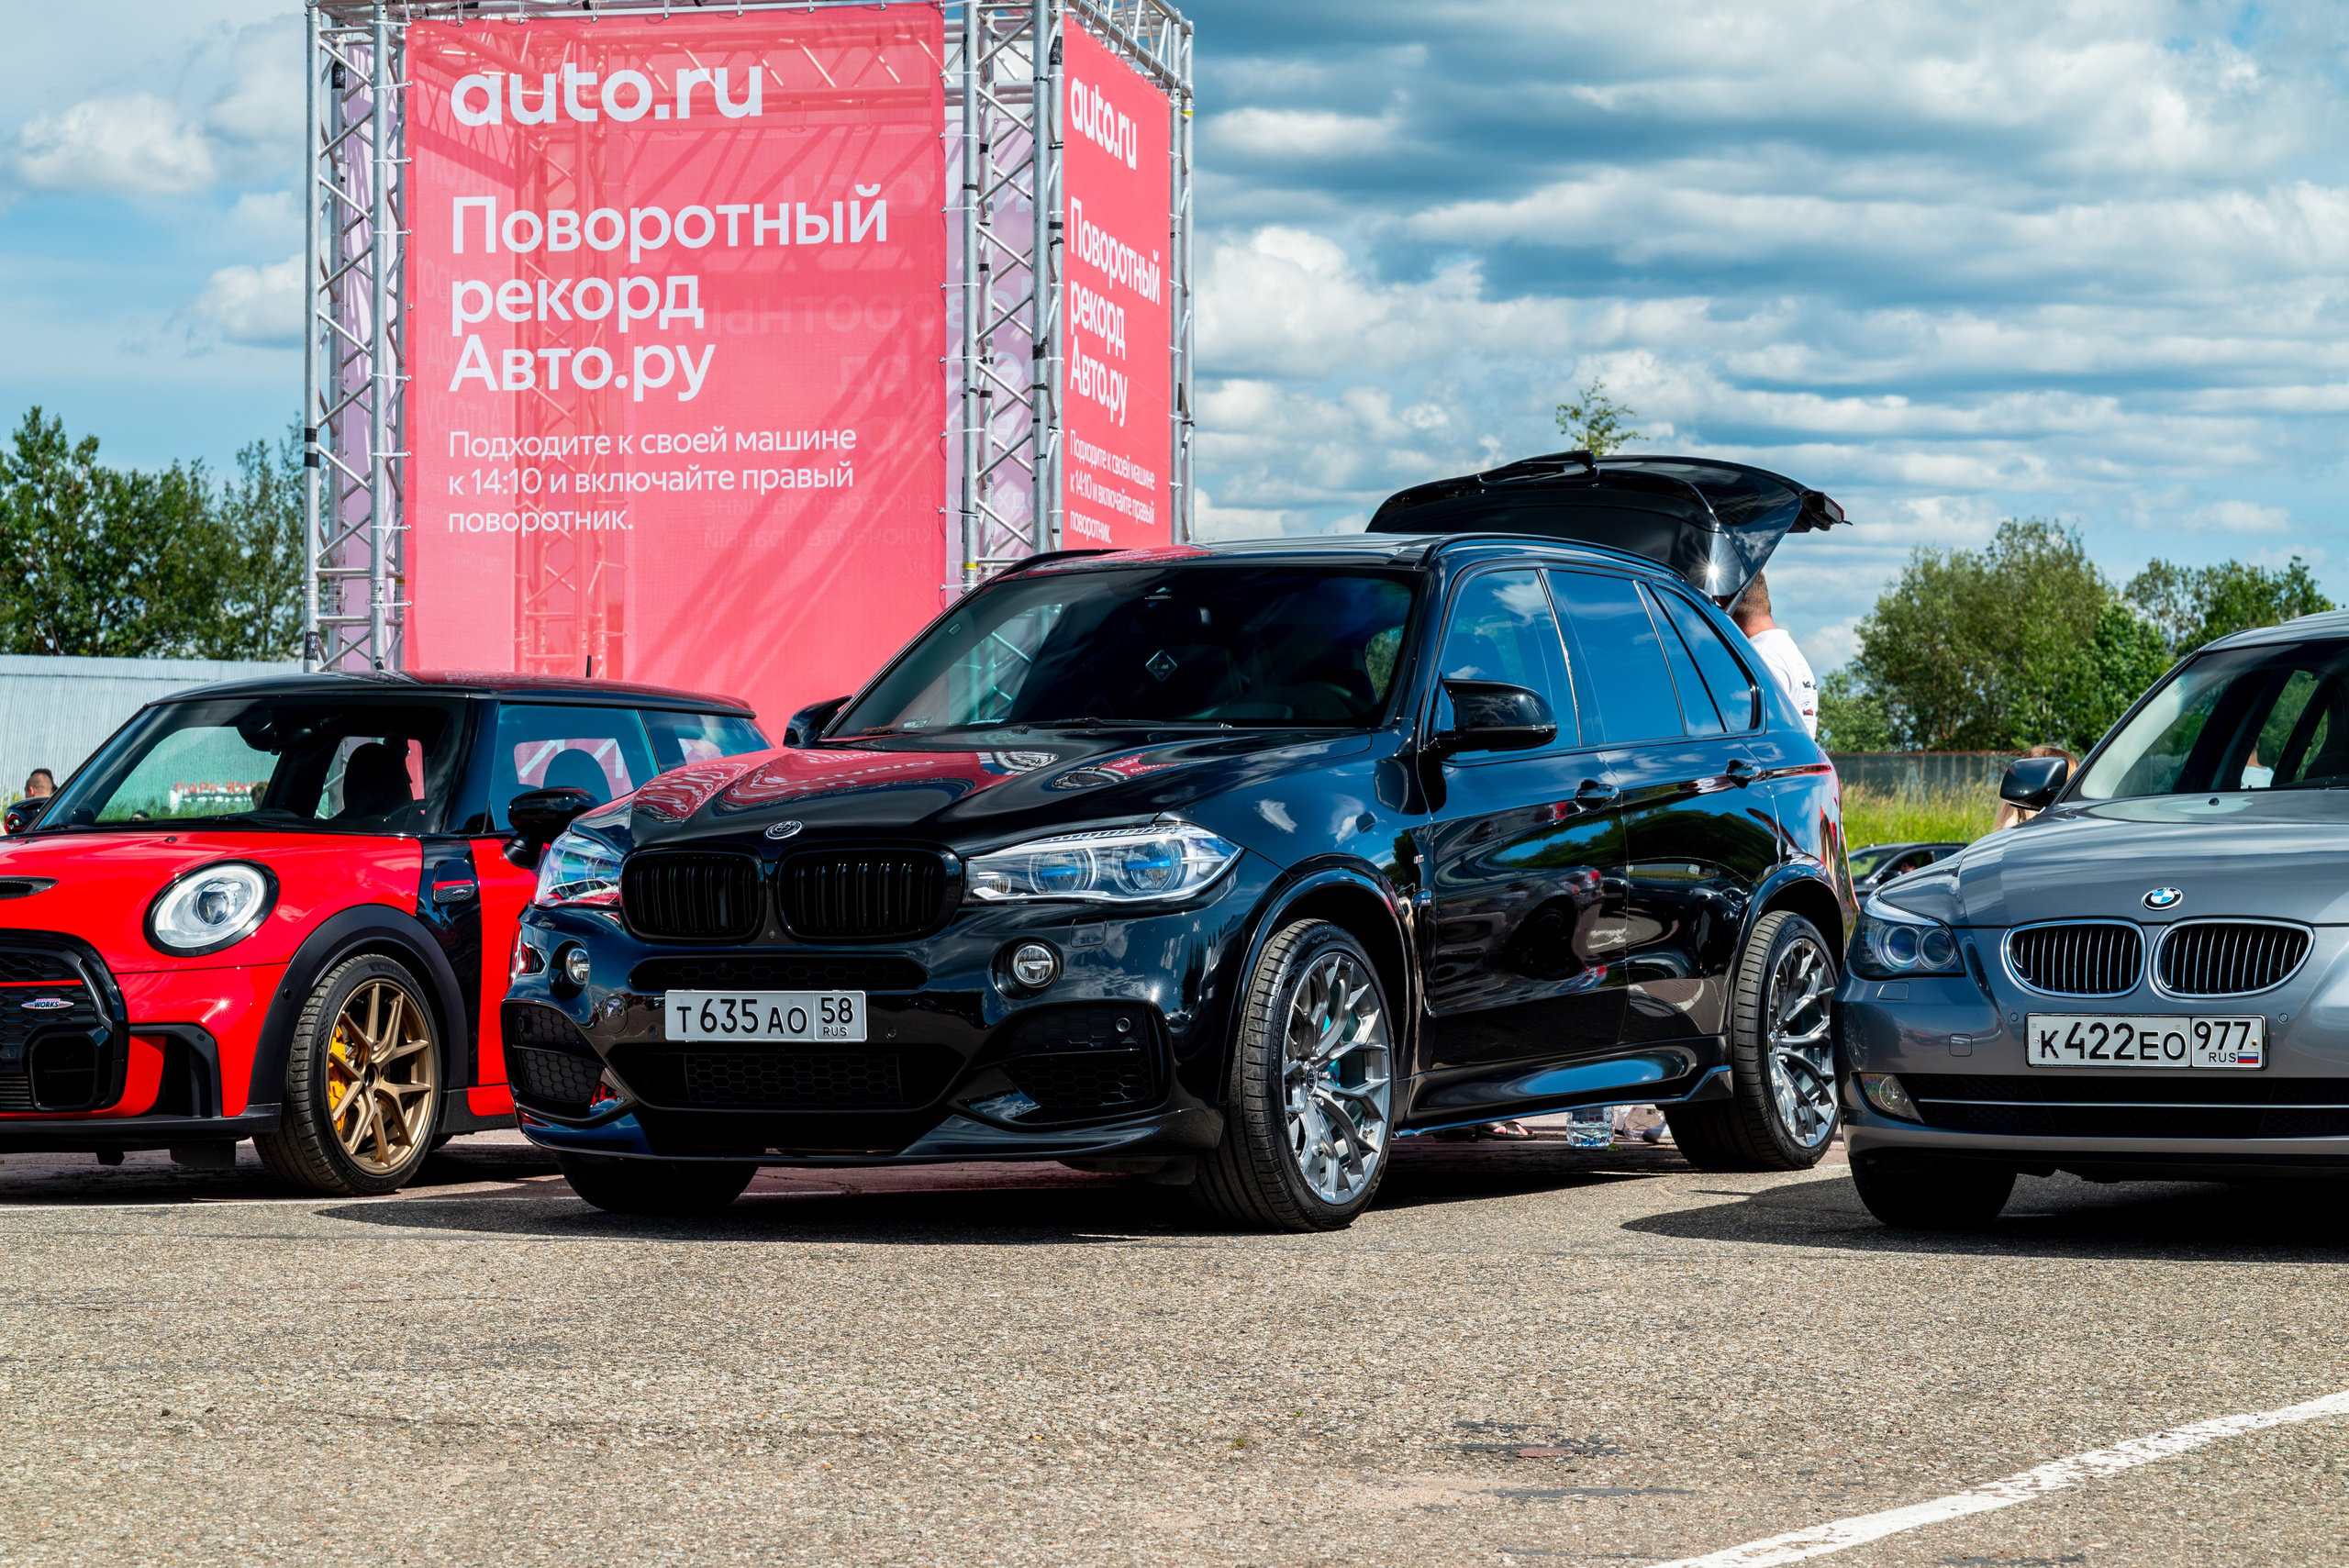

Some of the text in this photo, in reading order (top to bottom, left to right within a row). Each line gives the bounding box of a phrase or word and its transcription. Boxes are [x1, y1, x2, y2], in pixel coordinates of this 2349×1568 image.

[451, 62, 763, 126] auto.ru
[1071, 77, 1137, 171] auto.ru
[452, 183, 887, 263] Поворотный
[1070, 195, 1161, 306] Поворотный
[451, 274, 705, 337] рекорд
[1070, 280, 1126, 361] рекорд
[449, 333, 716, 402] Авто.ру
[1070, 335, 1128, 428] Авто.ру
[449, 431, 612, 462] Подходите
[618, 435, 634, 455] к
[640, 426, 728, 455] своей
[735, 428, 857, 452] машине
[1070, 428, 1155, 492] Подходите к своей машине
[449, 475, 465, 495] к
[470, 466, 542, 495] 14:10
[550, 473, 567, 494] и
[574, 463, 735, 494] включайте
[741, 461, 854, 496] правый
[1070, 469, 1155, 527] к 14:10 и включайте правый
[448, 508, 635, 539] поворотник.
[1070, 509, 1113, 545] поворотник.
[820, 996, 854, 1024] 58
[822, 1026, 848, 1037] RUS
[2194, 1020, 2252, 1051] 977
[2208, 1051, 2237, 1062] RUS
